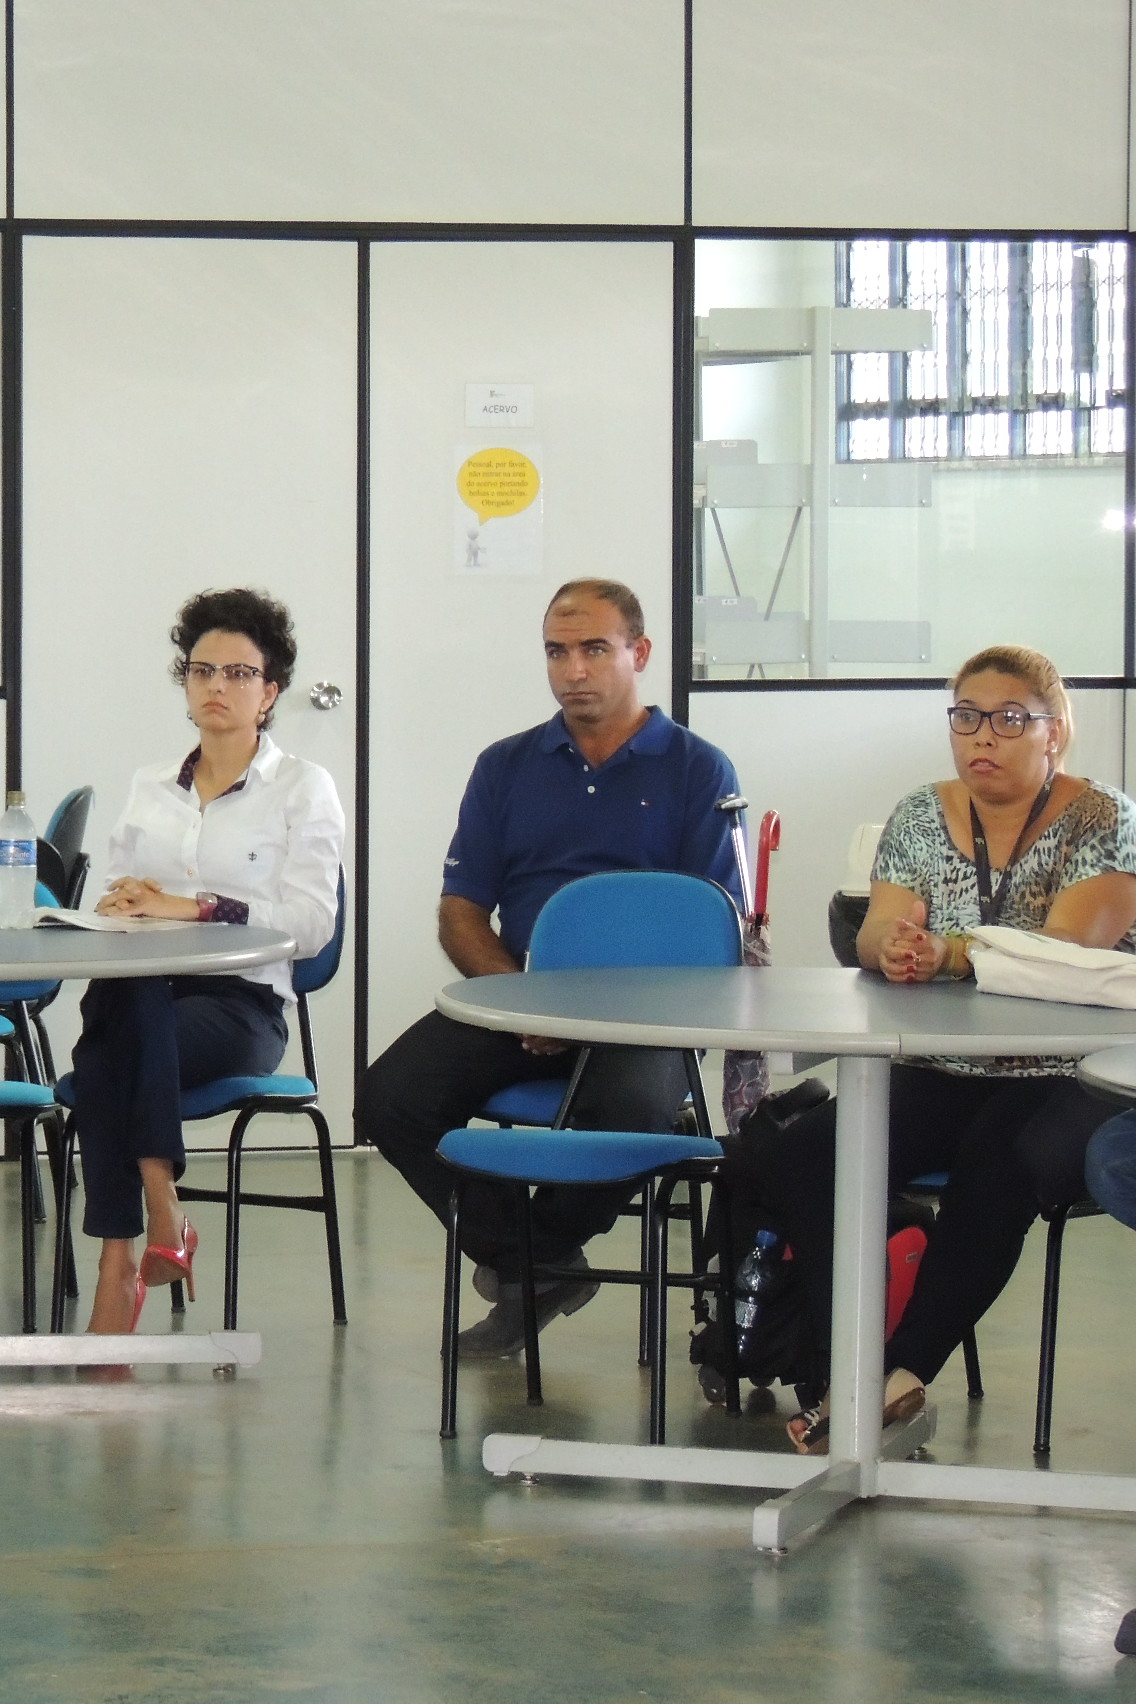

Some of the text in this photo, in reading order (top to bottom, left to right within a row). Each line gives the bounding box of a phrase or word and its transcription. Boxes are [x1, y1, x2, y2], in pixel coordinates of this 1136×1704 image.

[482, 404, 518, 414] ACERVO
[495, 462, 506, 470] por
[468, 470, 480, 478] não
[466, 479, 475, 487] do
